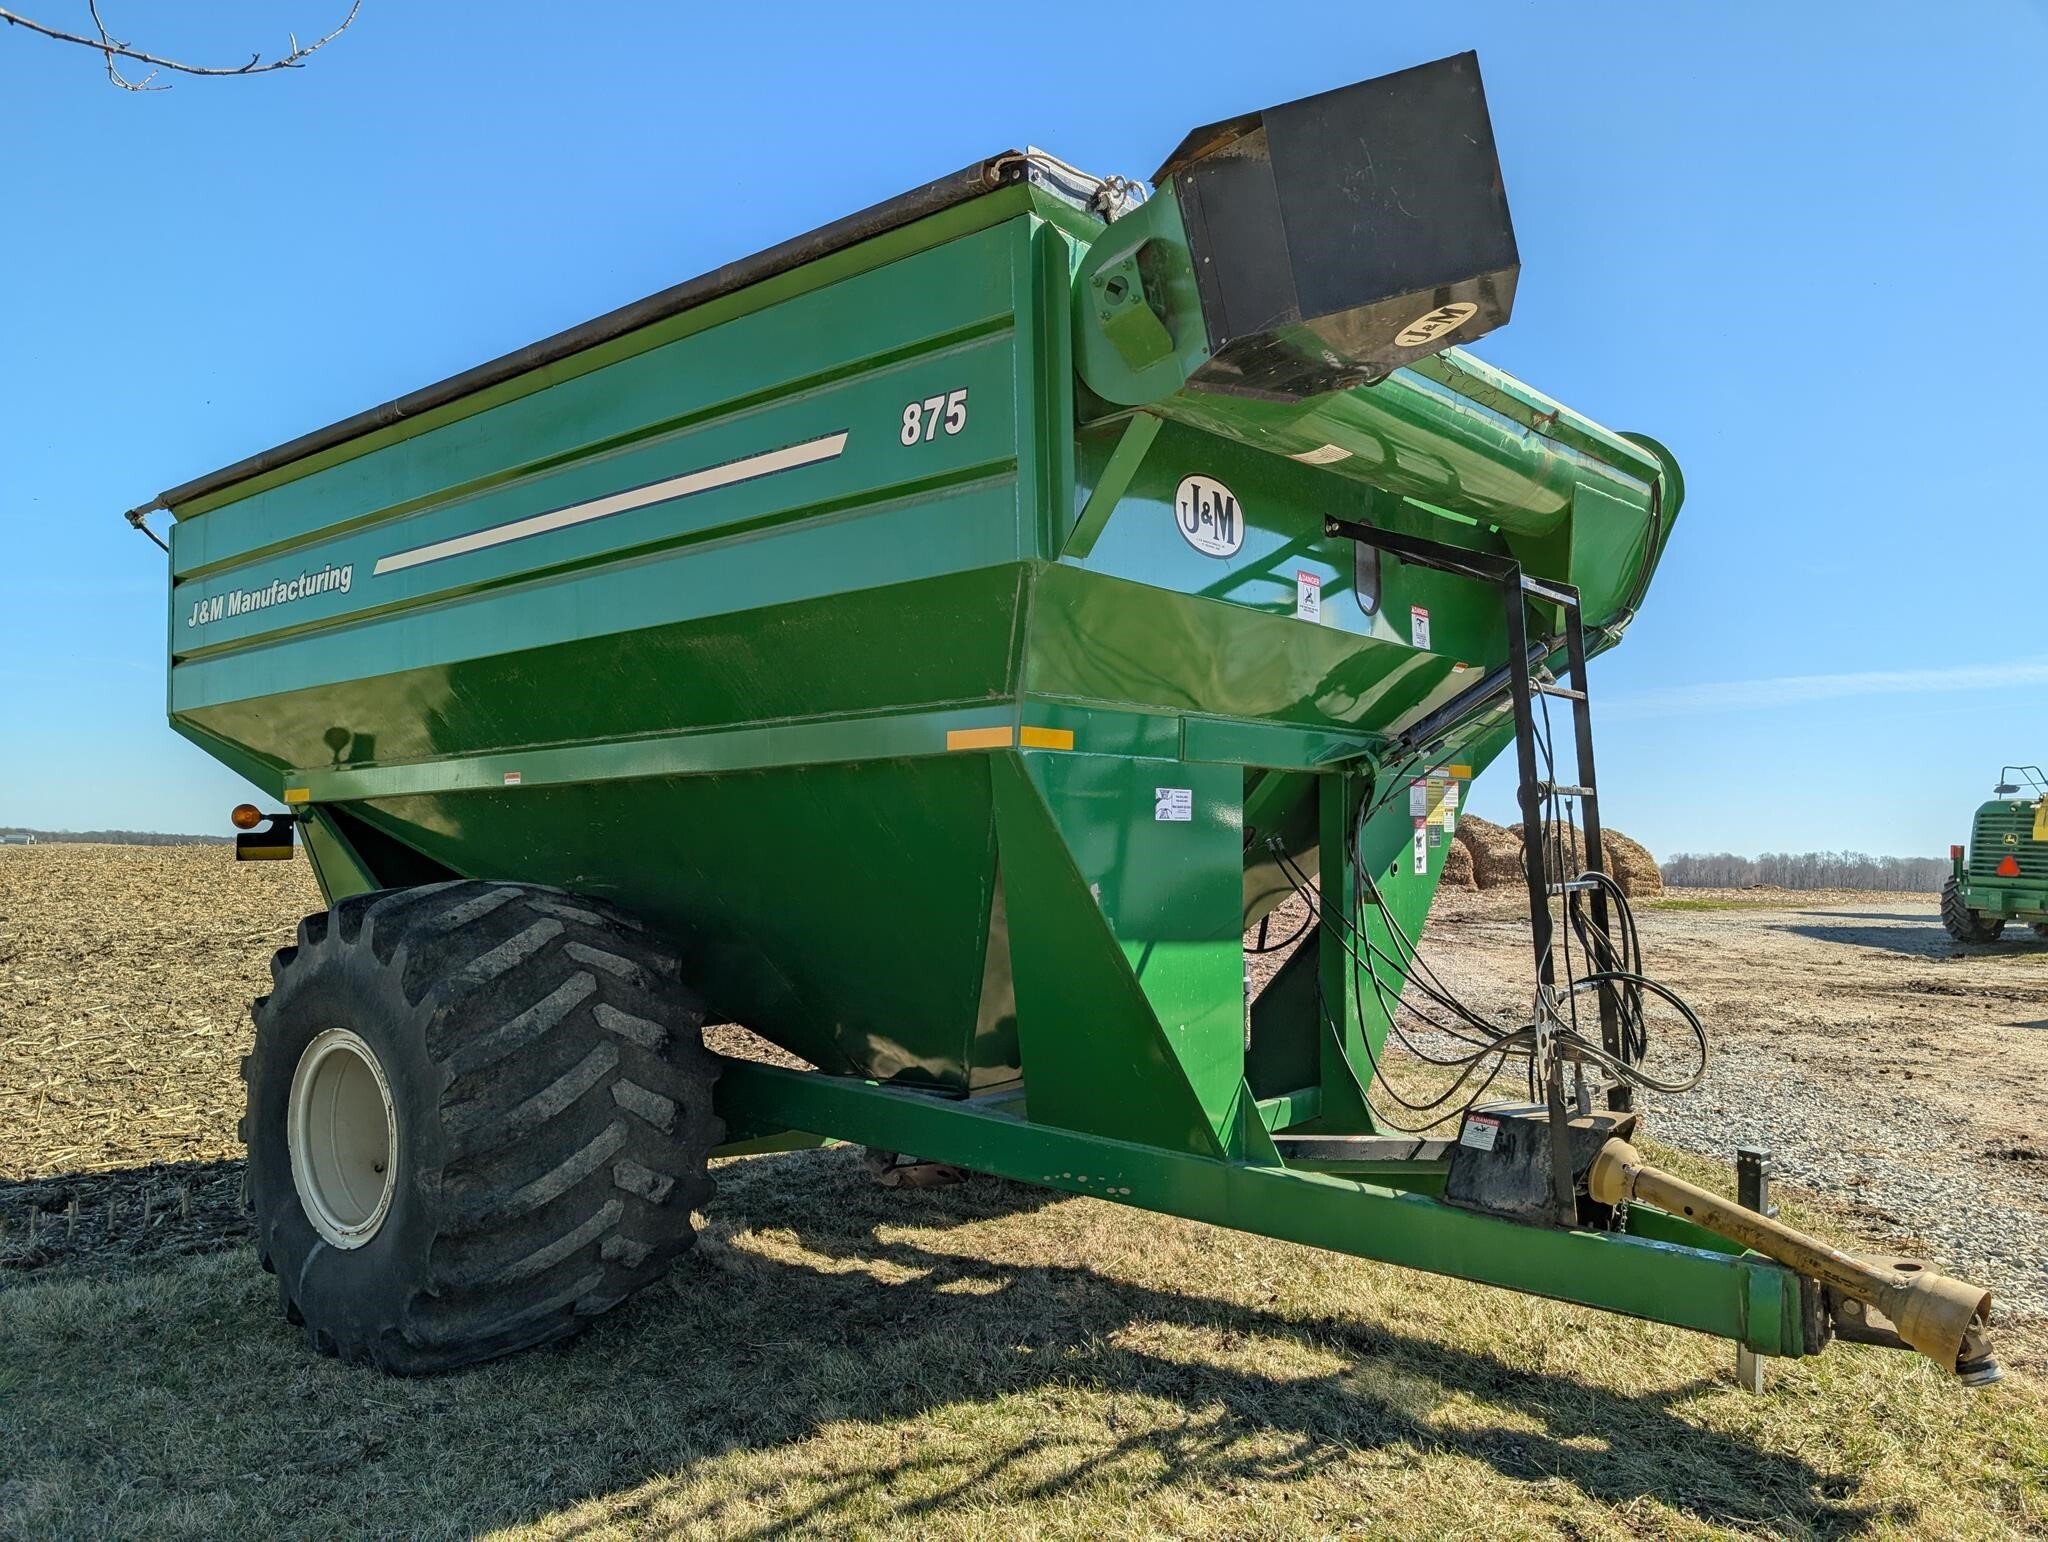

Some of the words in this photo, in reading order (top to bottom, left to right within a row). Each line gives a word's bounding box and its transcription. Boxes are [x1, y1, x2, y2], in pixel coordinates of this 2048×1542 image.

[1403, 306, 1471, 343] J&M
[900, 387, 968, 447] 875
[1181, 483, 1235, 545] J&M
[187, 593, 224, 628] J&M
[226, 562, 354, 618] Manufacturing
[1475, 1116, 1500, 1126] DANGER
